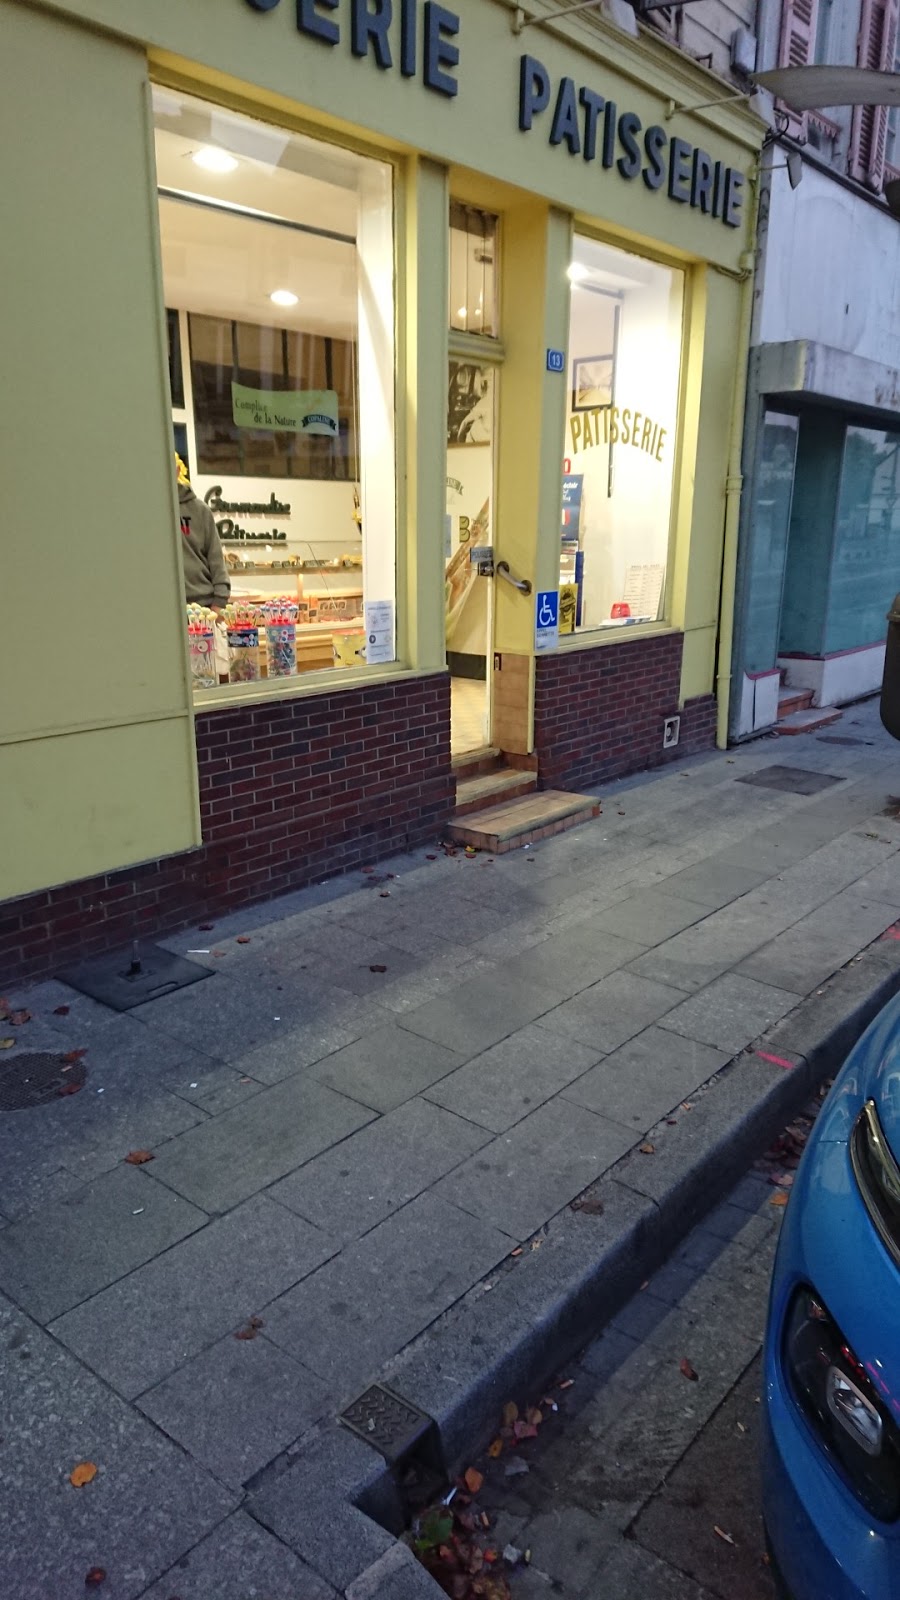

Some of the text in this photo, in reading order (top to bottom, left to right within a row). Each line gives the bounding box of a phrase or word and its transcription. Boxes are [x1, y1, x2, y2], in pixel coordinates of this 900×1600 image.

[518, 54, 744, 228] PATISSERIE
[551, 354, 561, 367] 13
[235, 398, 267, 413] Complice
[254, 412, 297, 427] de la Nature
[570, 407, 667, 462] PATISSERIE
